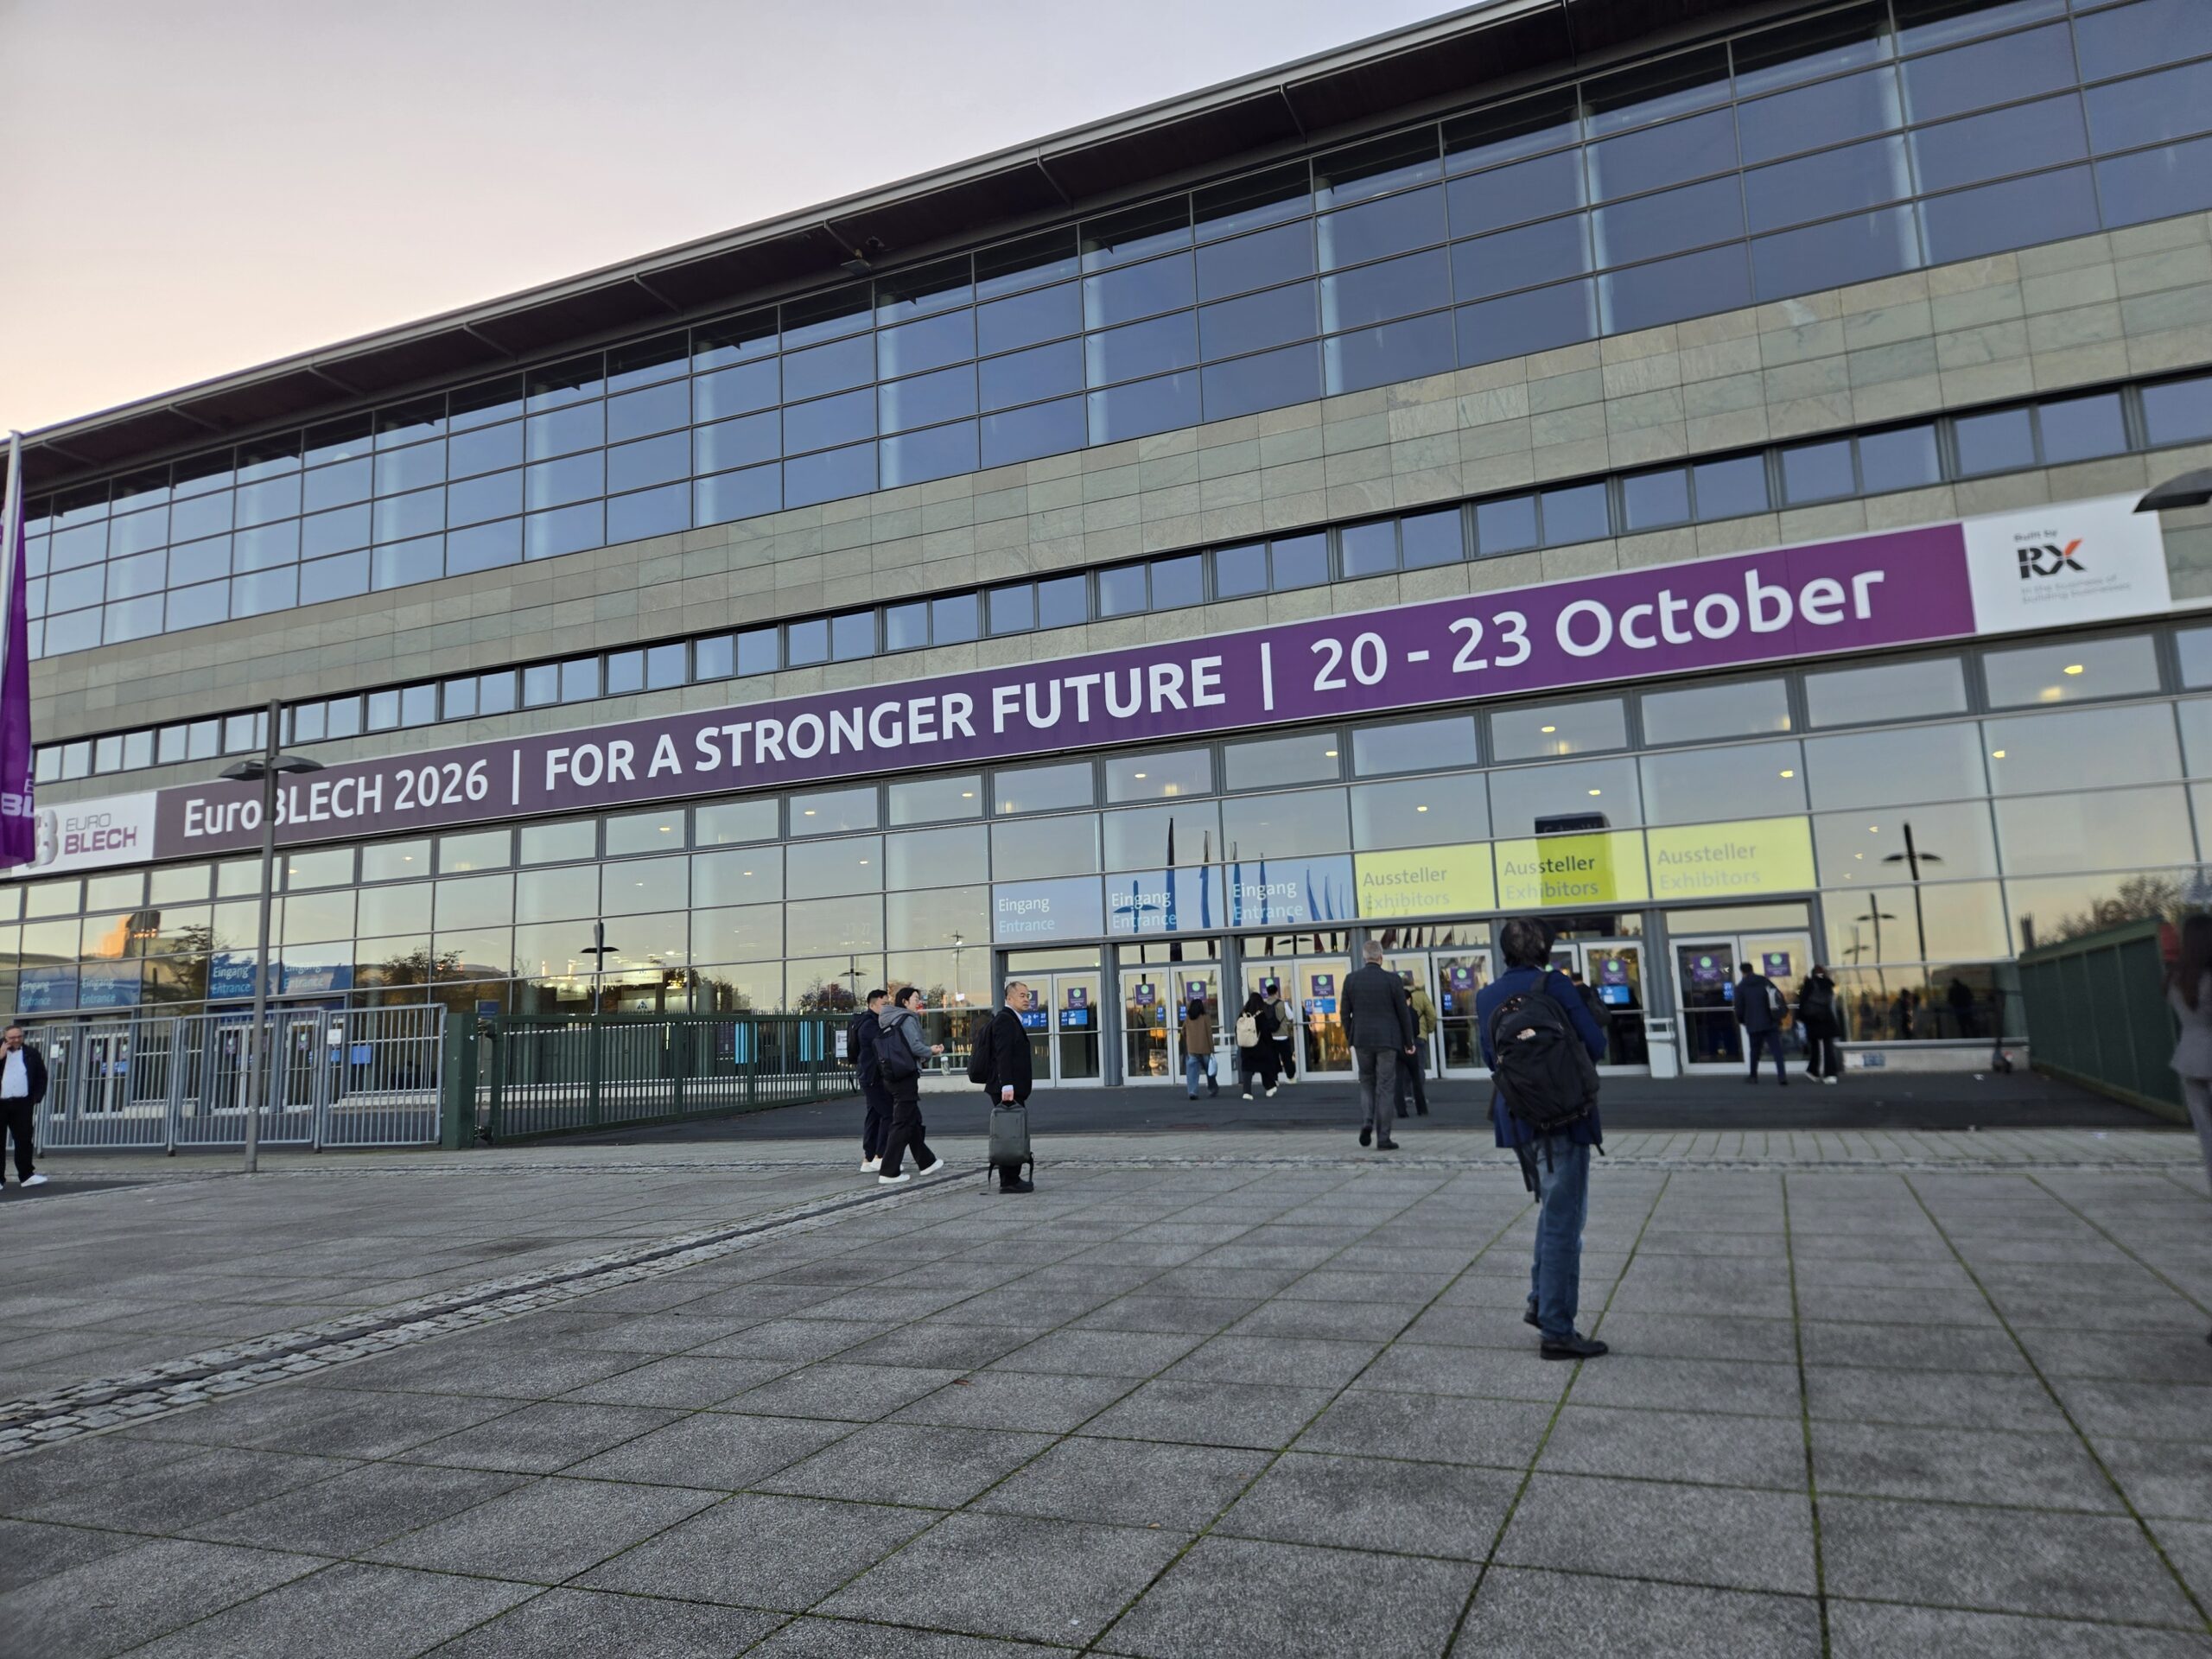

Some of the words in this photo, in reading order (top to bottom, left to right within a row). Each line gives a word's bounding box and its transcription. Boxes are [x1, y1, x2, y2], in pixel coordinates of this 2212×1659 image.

[2017, 537, 2087, 580] RX
[395, 760, 488, 810] 2026
[546, 741, 635, 791] FOR
[647, 734, 683, 778] A
[695, 692, 976, 772] STRONGER
[992, 655, 1226, 734] FUTURE
[1310, 632, 1388, 691] 20
[1448, 611, 1532, 673] 23
[1555, 569, 1885, 657] October
[66, 813, 111, 833] EURO
[64, 826, 138, 855] BLECH
[1657, 843, 1757, 865] Aussteller
[1504, 855, 1596, 876] Aussteller
[1363, 867, 1448, 887] Aussteller
[1659, 869, 1761, 891] Exhibitors
[1233, 880, 1297, 900] Eingang
[1506, 880, 1599, 900] Exhibitors
[998, 898, 1051, 913] Eingang
[1111, 892, 1172, 910] Eingang
[1364, 891, 1451, 910] Exhibitors
[1234, 902, 1304, 920] Entrance
[999, 918, 1056, 933] Entrance
[1112, 913, 1178, 930] Entrance
[213, 966, 250, 980] Eingang
[21, 981, 50, 994] Eingang
[81, 977, 115, 991] Eingang
[212, 982, 251, 995] Entrance
[20, 996, 52, 1007] Entrance
[81, 994, 117, 1005] Entrance
